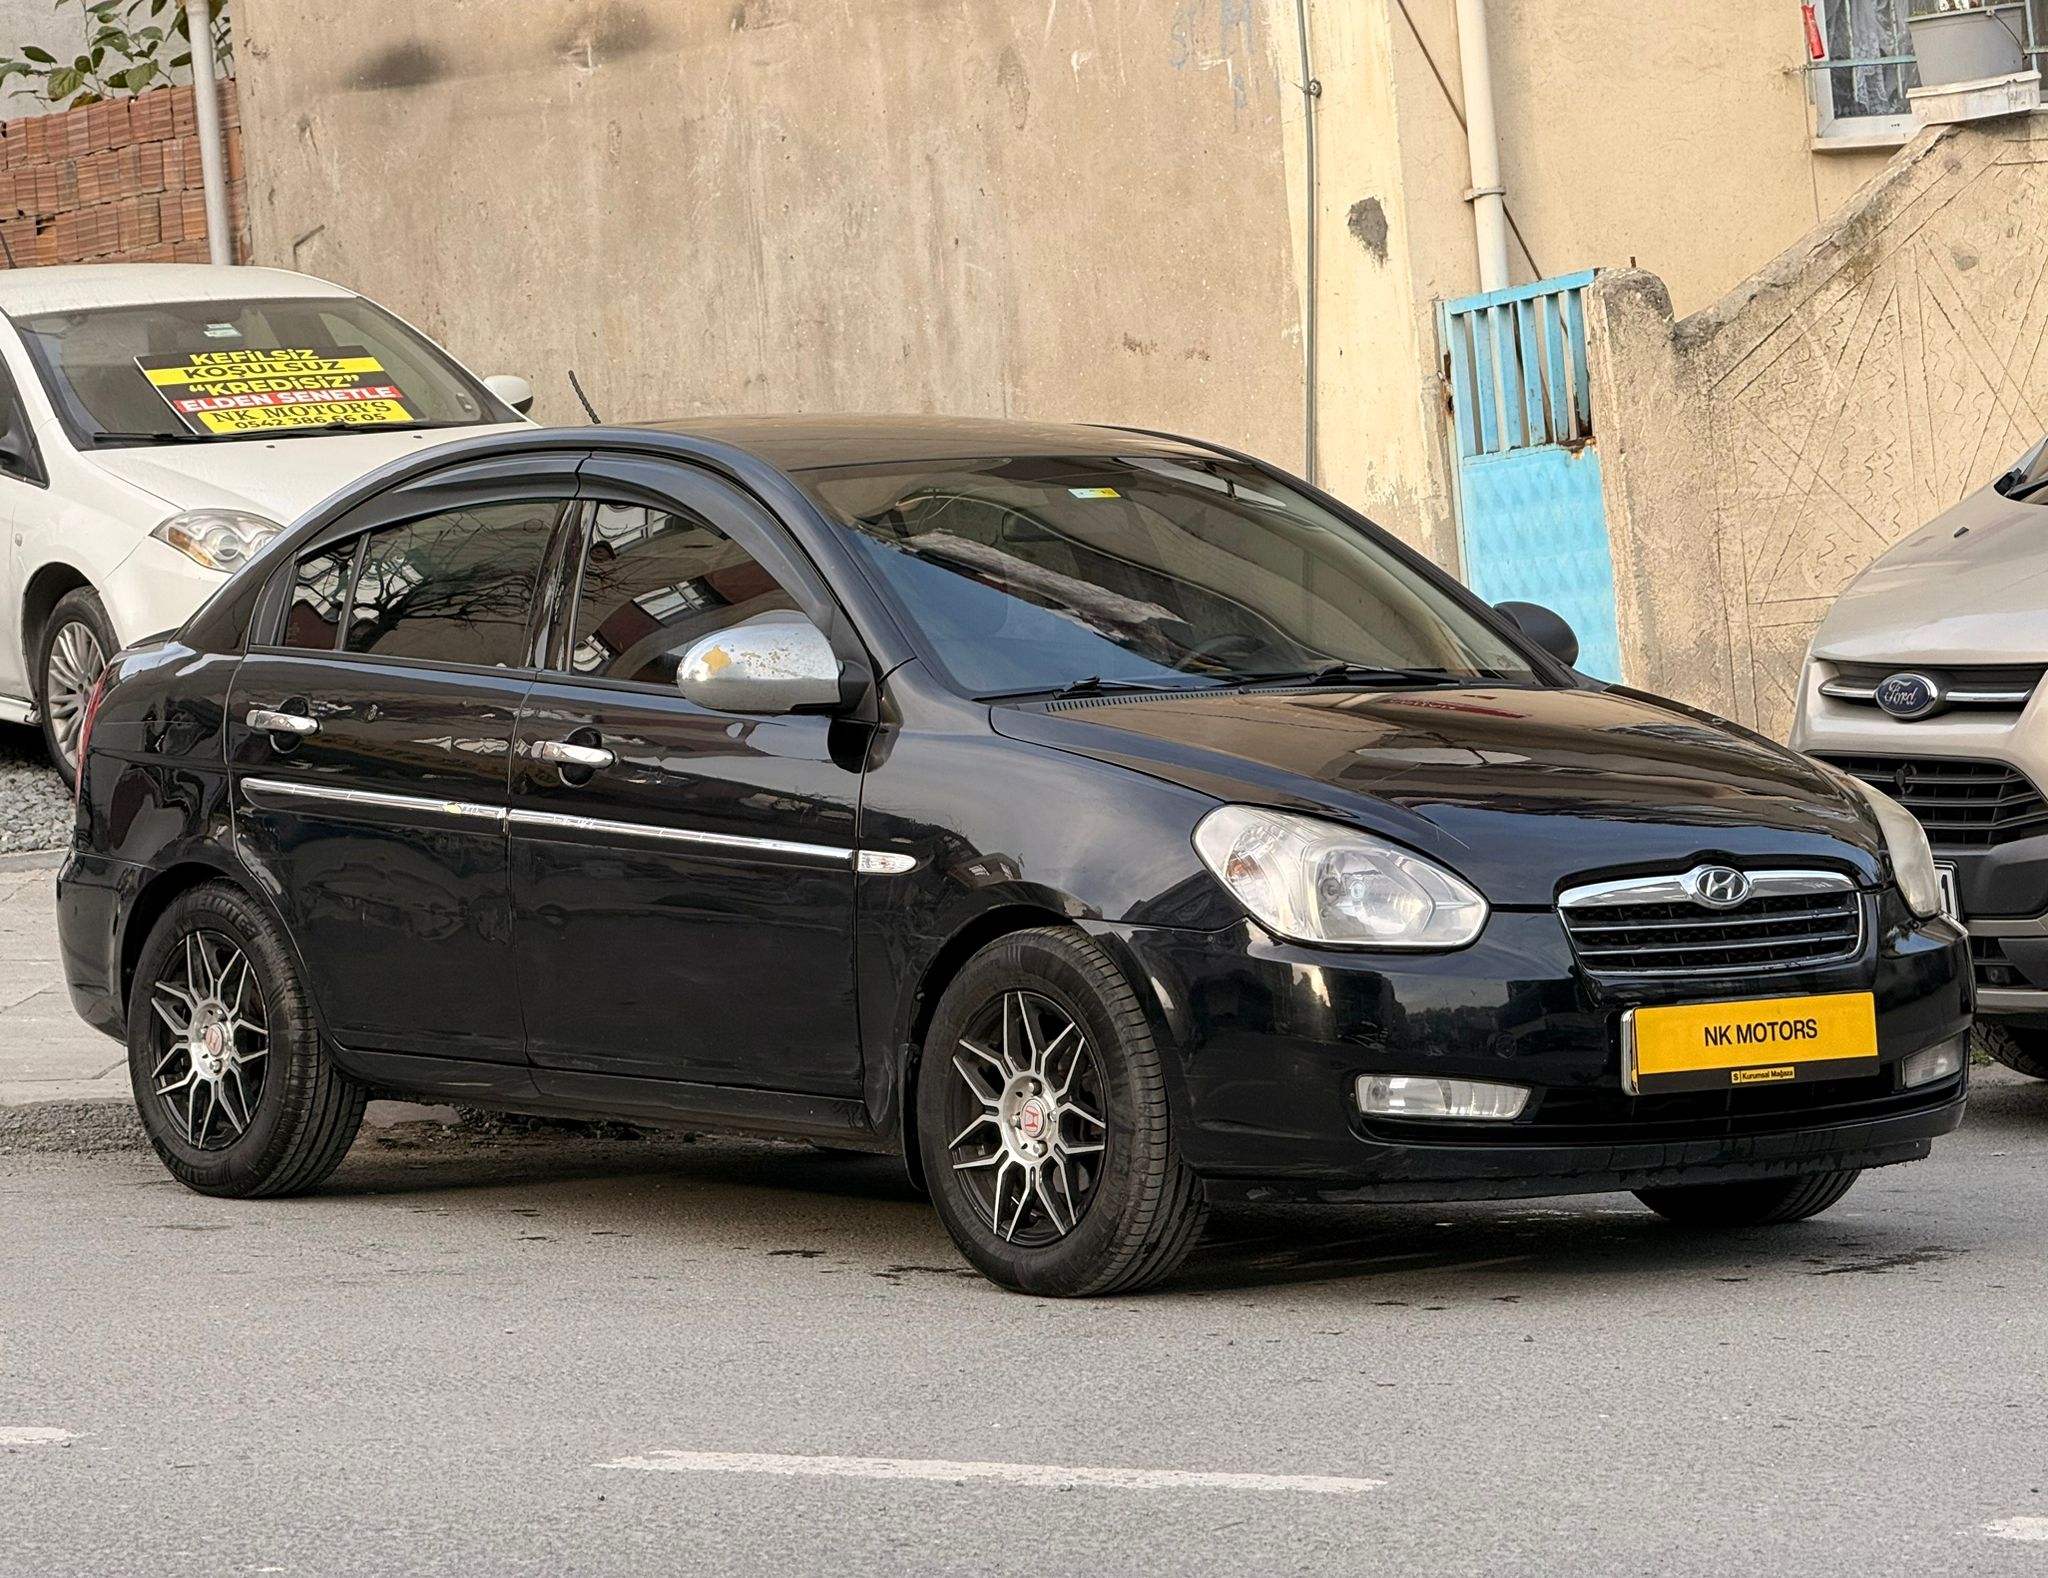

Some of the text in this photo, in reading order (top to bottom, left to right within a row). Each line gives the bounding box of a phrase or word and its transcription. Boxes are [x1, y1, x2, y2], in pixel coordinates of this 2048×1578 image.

[183, 360, 345, 378] KOŞULSUZ
[181, 386, 393, 412] ELDEN SENETLE
[211, 410, 257, 423] NK
[234, 418, 286, 430] 0542
[291, 415, 327, 425] 386
[360, 413, 386, 421] 05
[1884, 680, 1919, 706] Ford
[1704, 1019, 1818, 1046] NK MOTORS
[1742, 1071, 1770, 1080] Kurumsal
[1771, 1070, 1793, 1078] Mağaza
